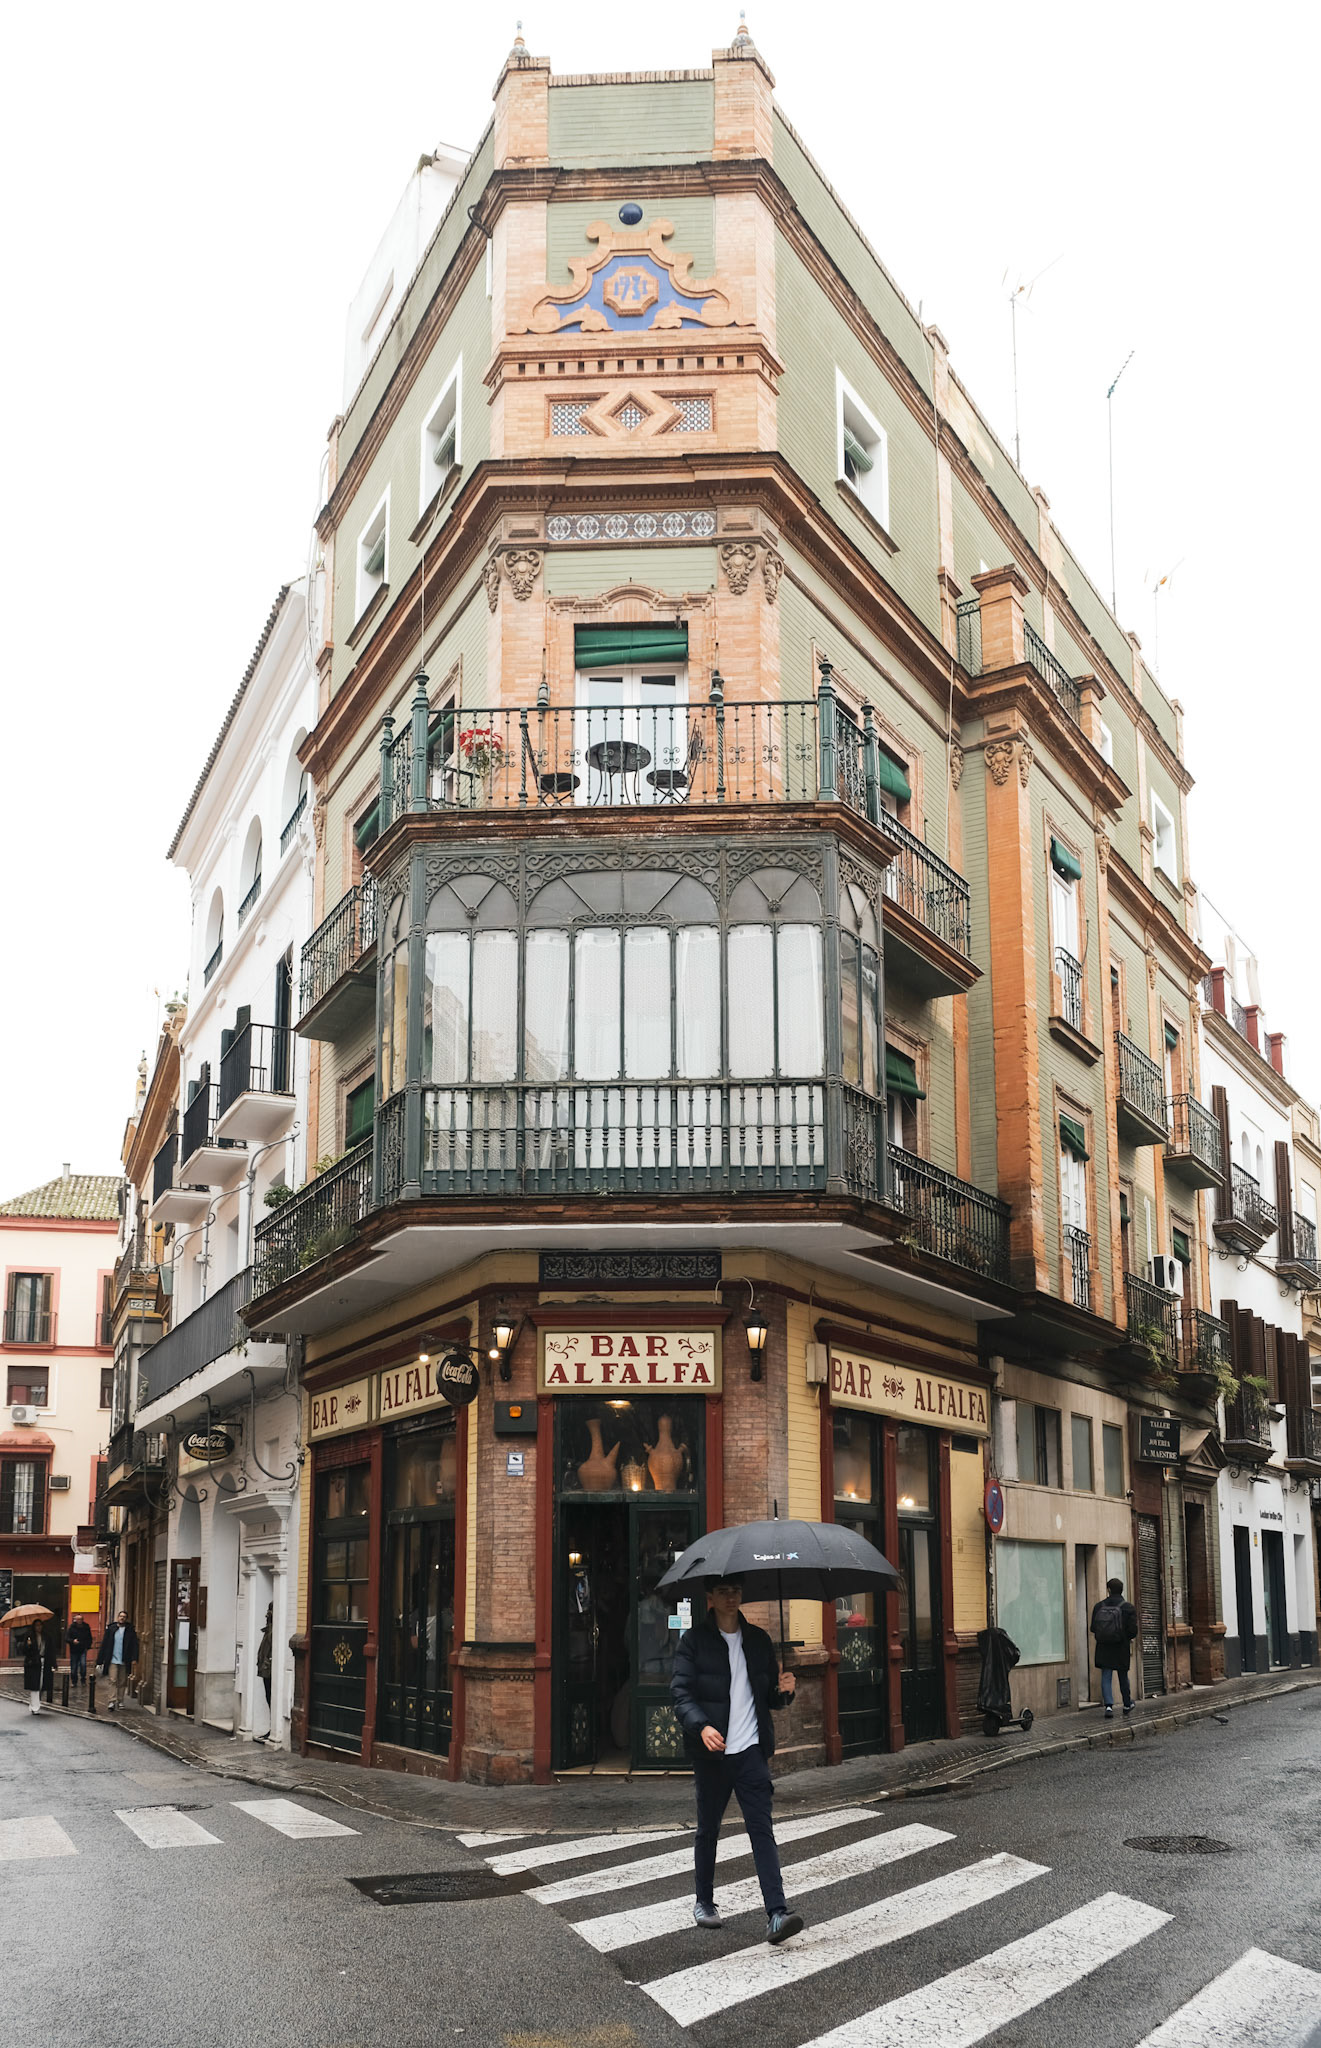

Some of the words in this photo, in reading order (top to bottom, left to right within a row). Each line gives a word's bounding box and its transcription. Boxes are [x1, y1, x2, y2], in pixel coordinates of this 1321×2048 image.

[590, 1335, 669, 1357] BAR
[546, 1362, 711, 1384] ALFALFA
[312, 1396, 339, 1430] BAR
[383, 1360, 440, 1411] ALFAL
[831, 1357, 872, 1399] BAR
[914, 1378, 986, 1424] ALFALFA
[1150, 1420, 1171, 1429] TALLER
[1150, 1449, 1178, 1460] MAESTRE
